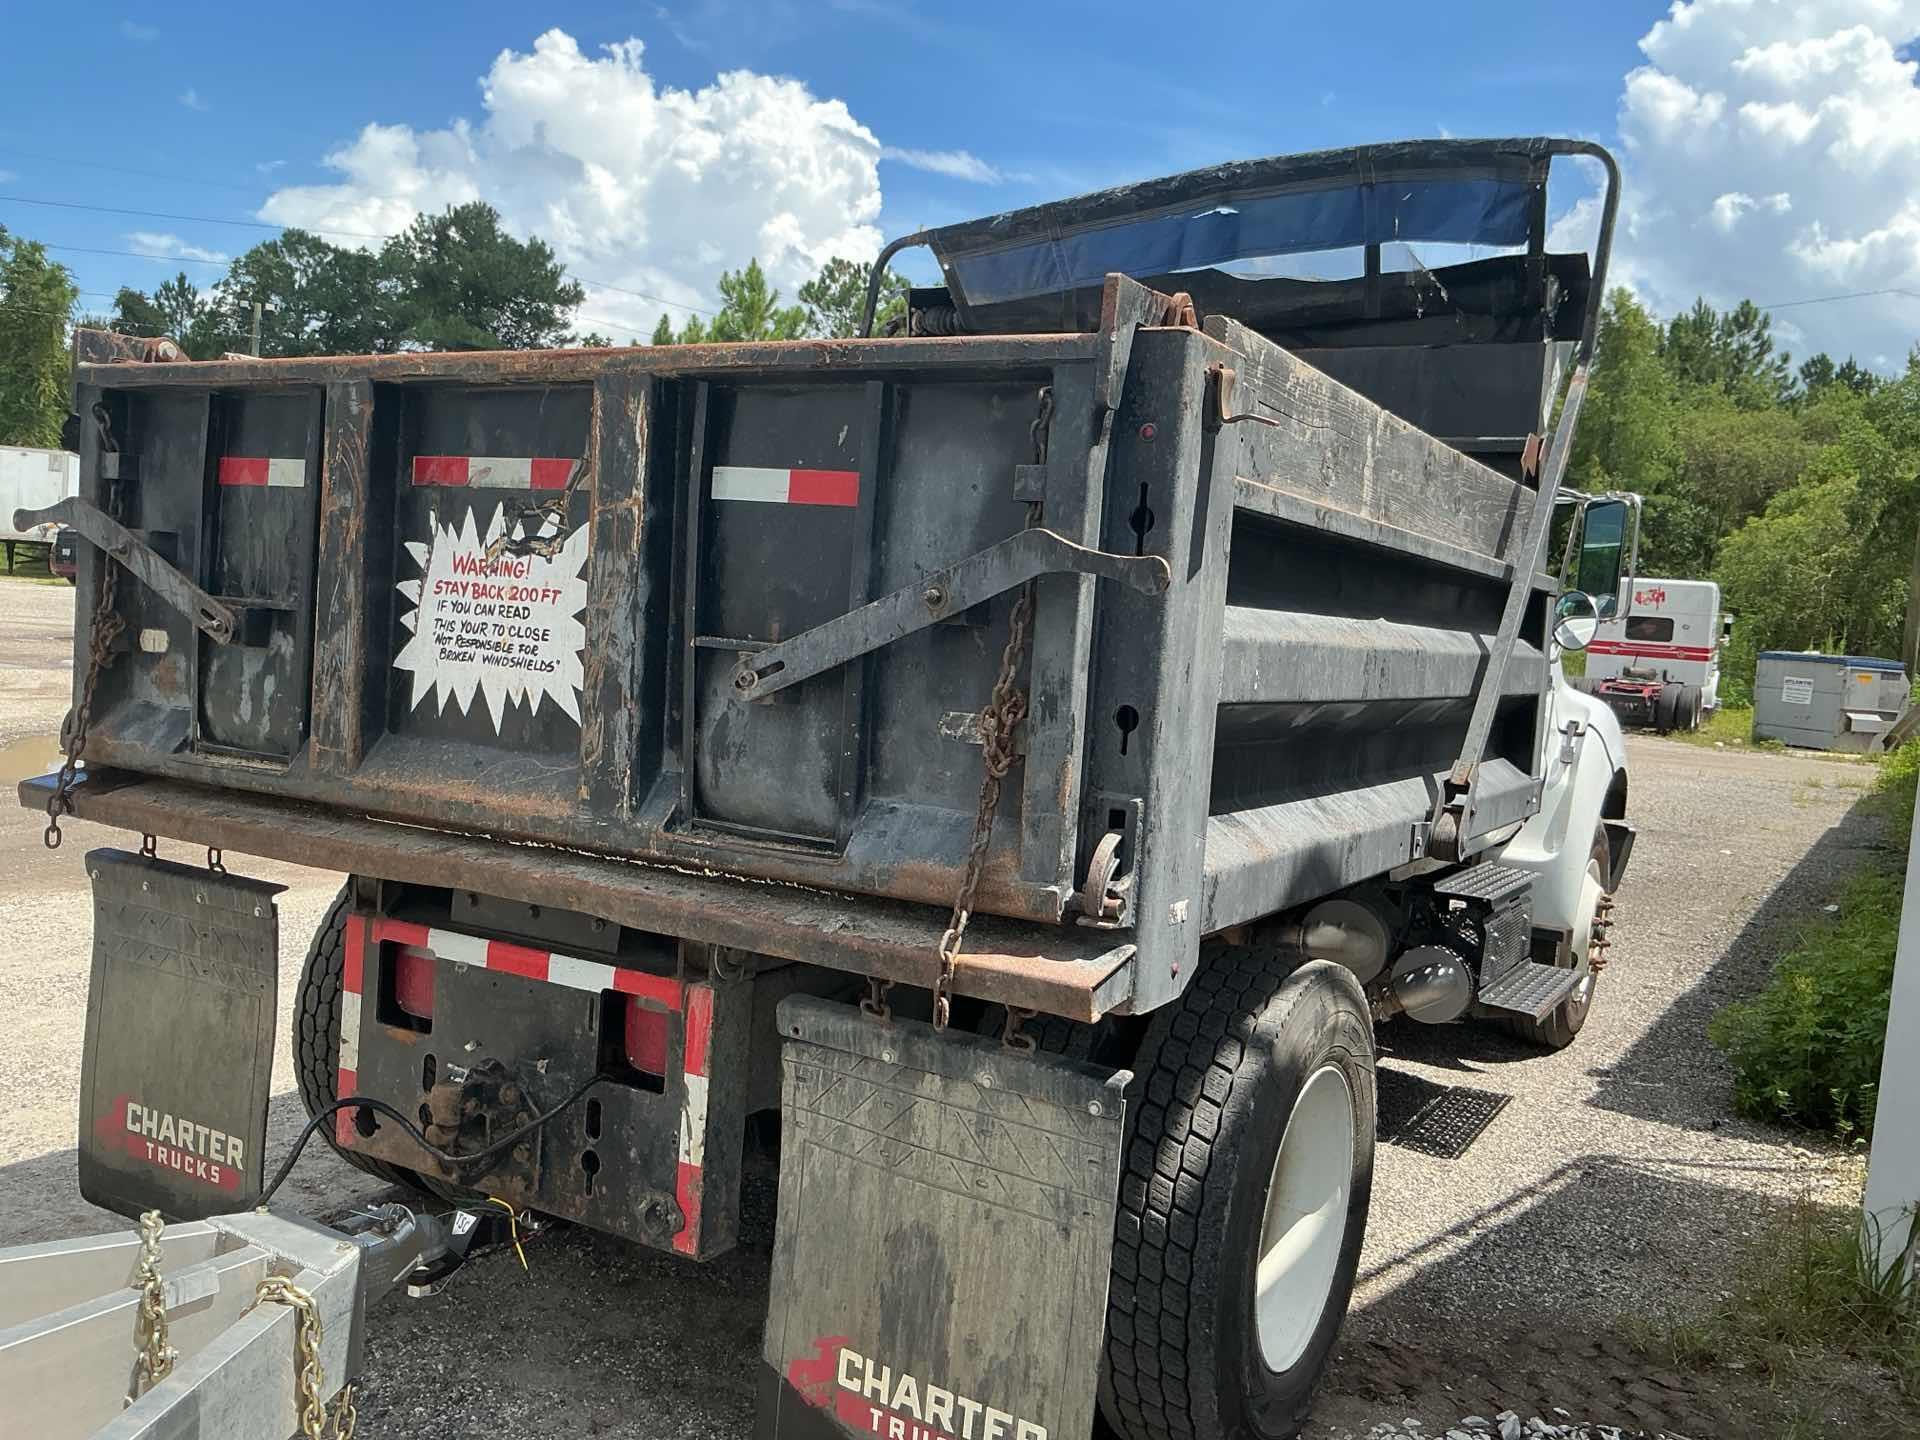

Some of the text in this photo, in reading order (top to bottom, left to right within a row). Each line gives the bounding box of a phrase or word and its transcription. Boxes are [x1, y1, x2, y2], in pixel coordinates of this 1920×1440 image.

[434, 580, 562, 605] STAY BACK 200 FT
[437, 600, 531, 620] IF YOU CAN READ
[434, 618, 551, 642] THIS YOUR TO CLOSE
[439, 648, 476, 662] BROKEN
[455, 634, 514, 654] RESPONSIBLE
[518, 645, 539, 657] FOR
[126, 1102, 244, 1170] CHARTER
[145, 1141, 220, 1184] TRUCKS
